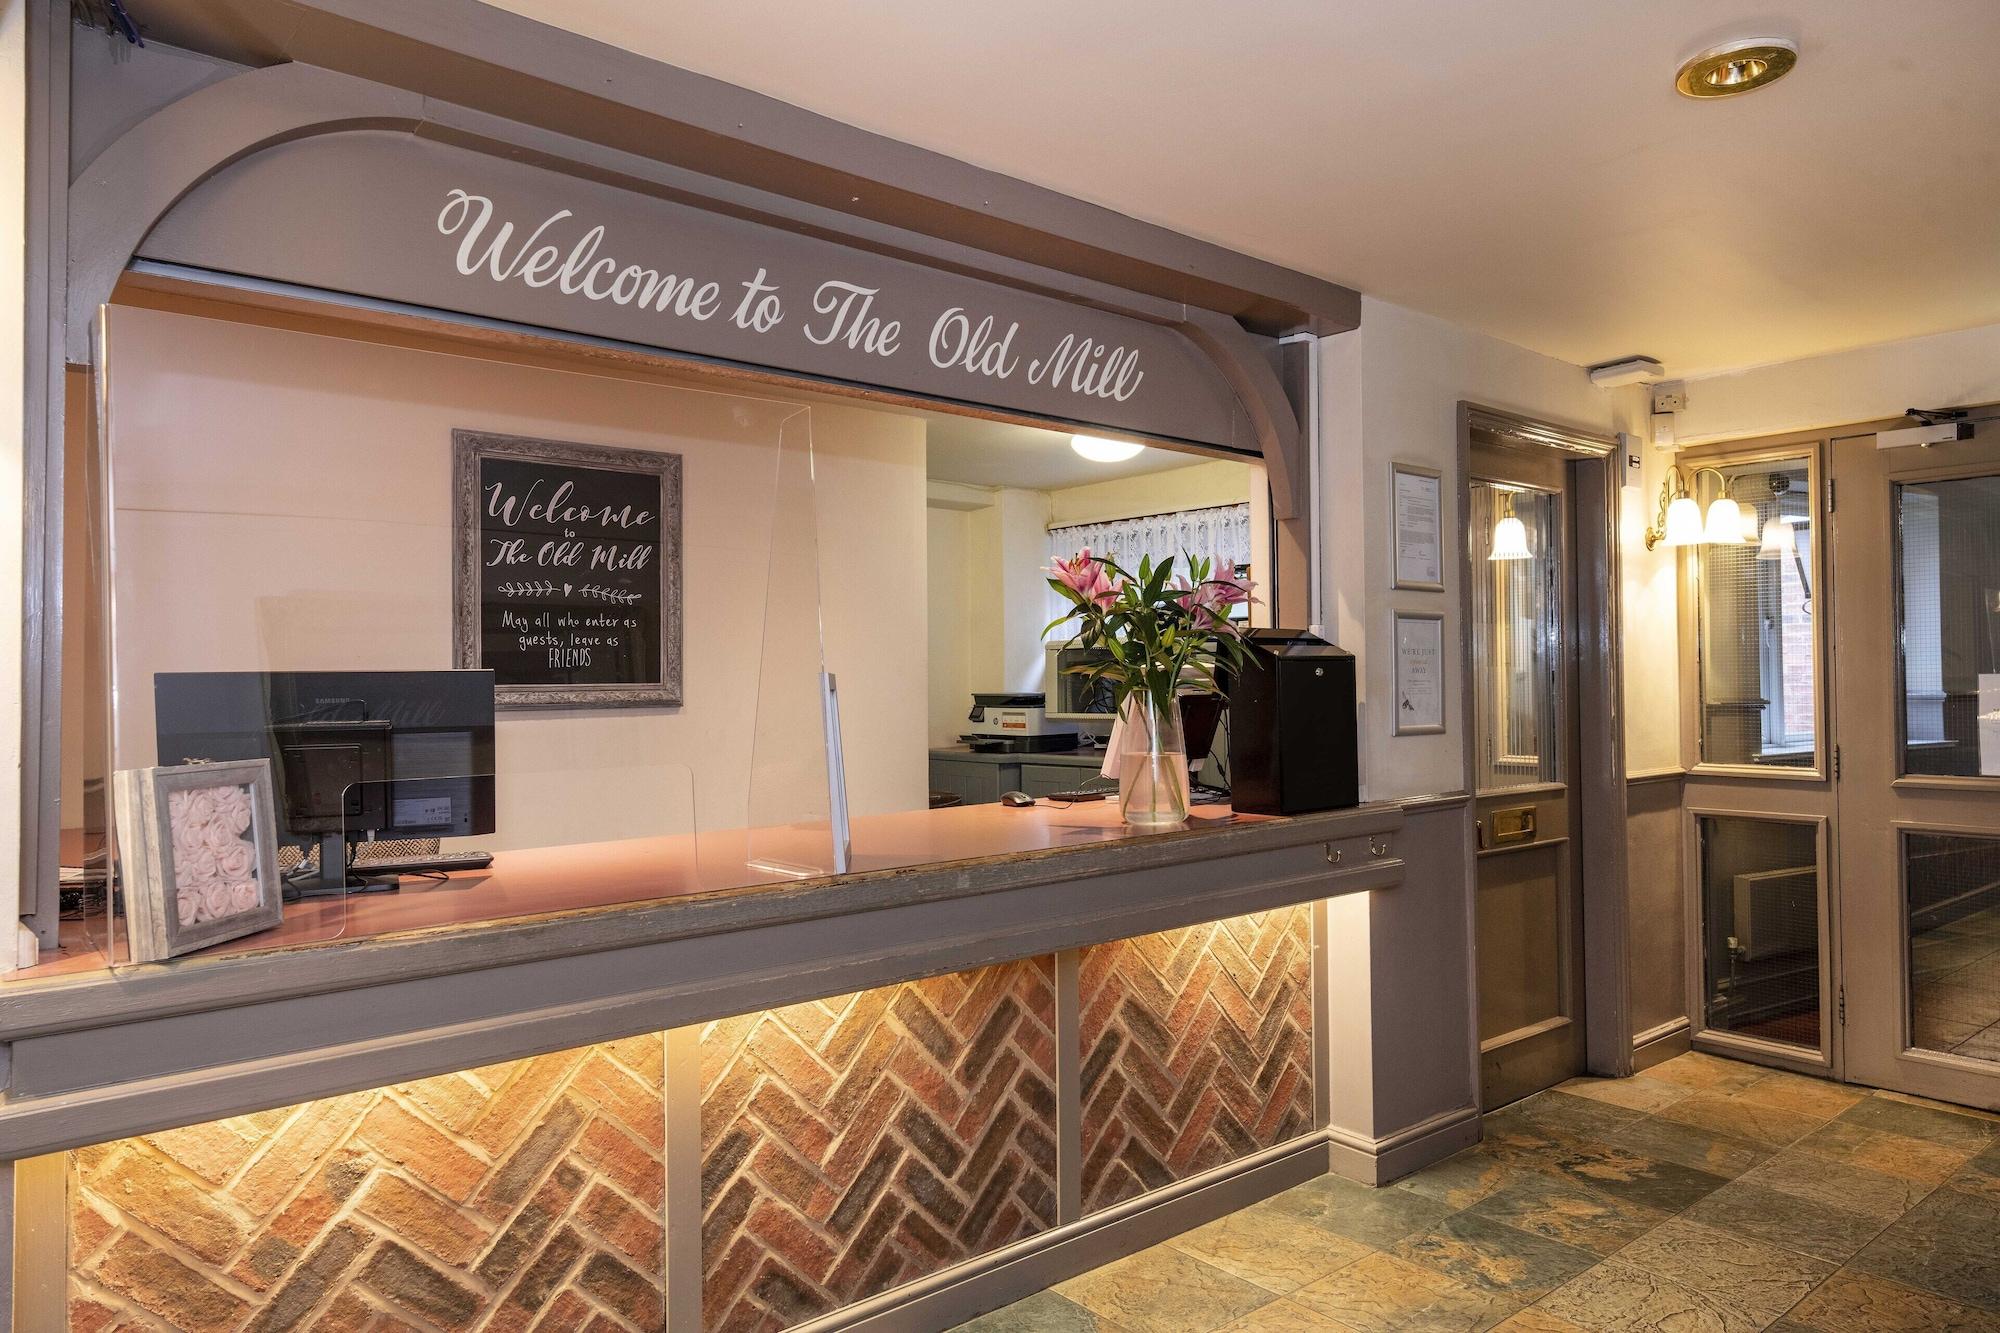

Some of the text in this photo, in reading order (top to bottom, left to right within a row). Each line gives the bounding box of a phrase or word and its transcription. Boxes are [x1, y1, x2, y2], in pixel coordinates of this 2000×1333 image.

[438, 188, 1144, 402] Welcome to The Old Mill
[485, 479, 656, 528] Welcome
[563, 527, 576, 538] to
[486, 538, 653, 572] The Old Mill
[501, 610, 637, 632] May all who enter as
[518, 631, 619, 651] guests, leave as
[548, 647, 592, 669] FRIENDS
